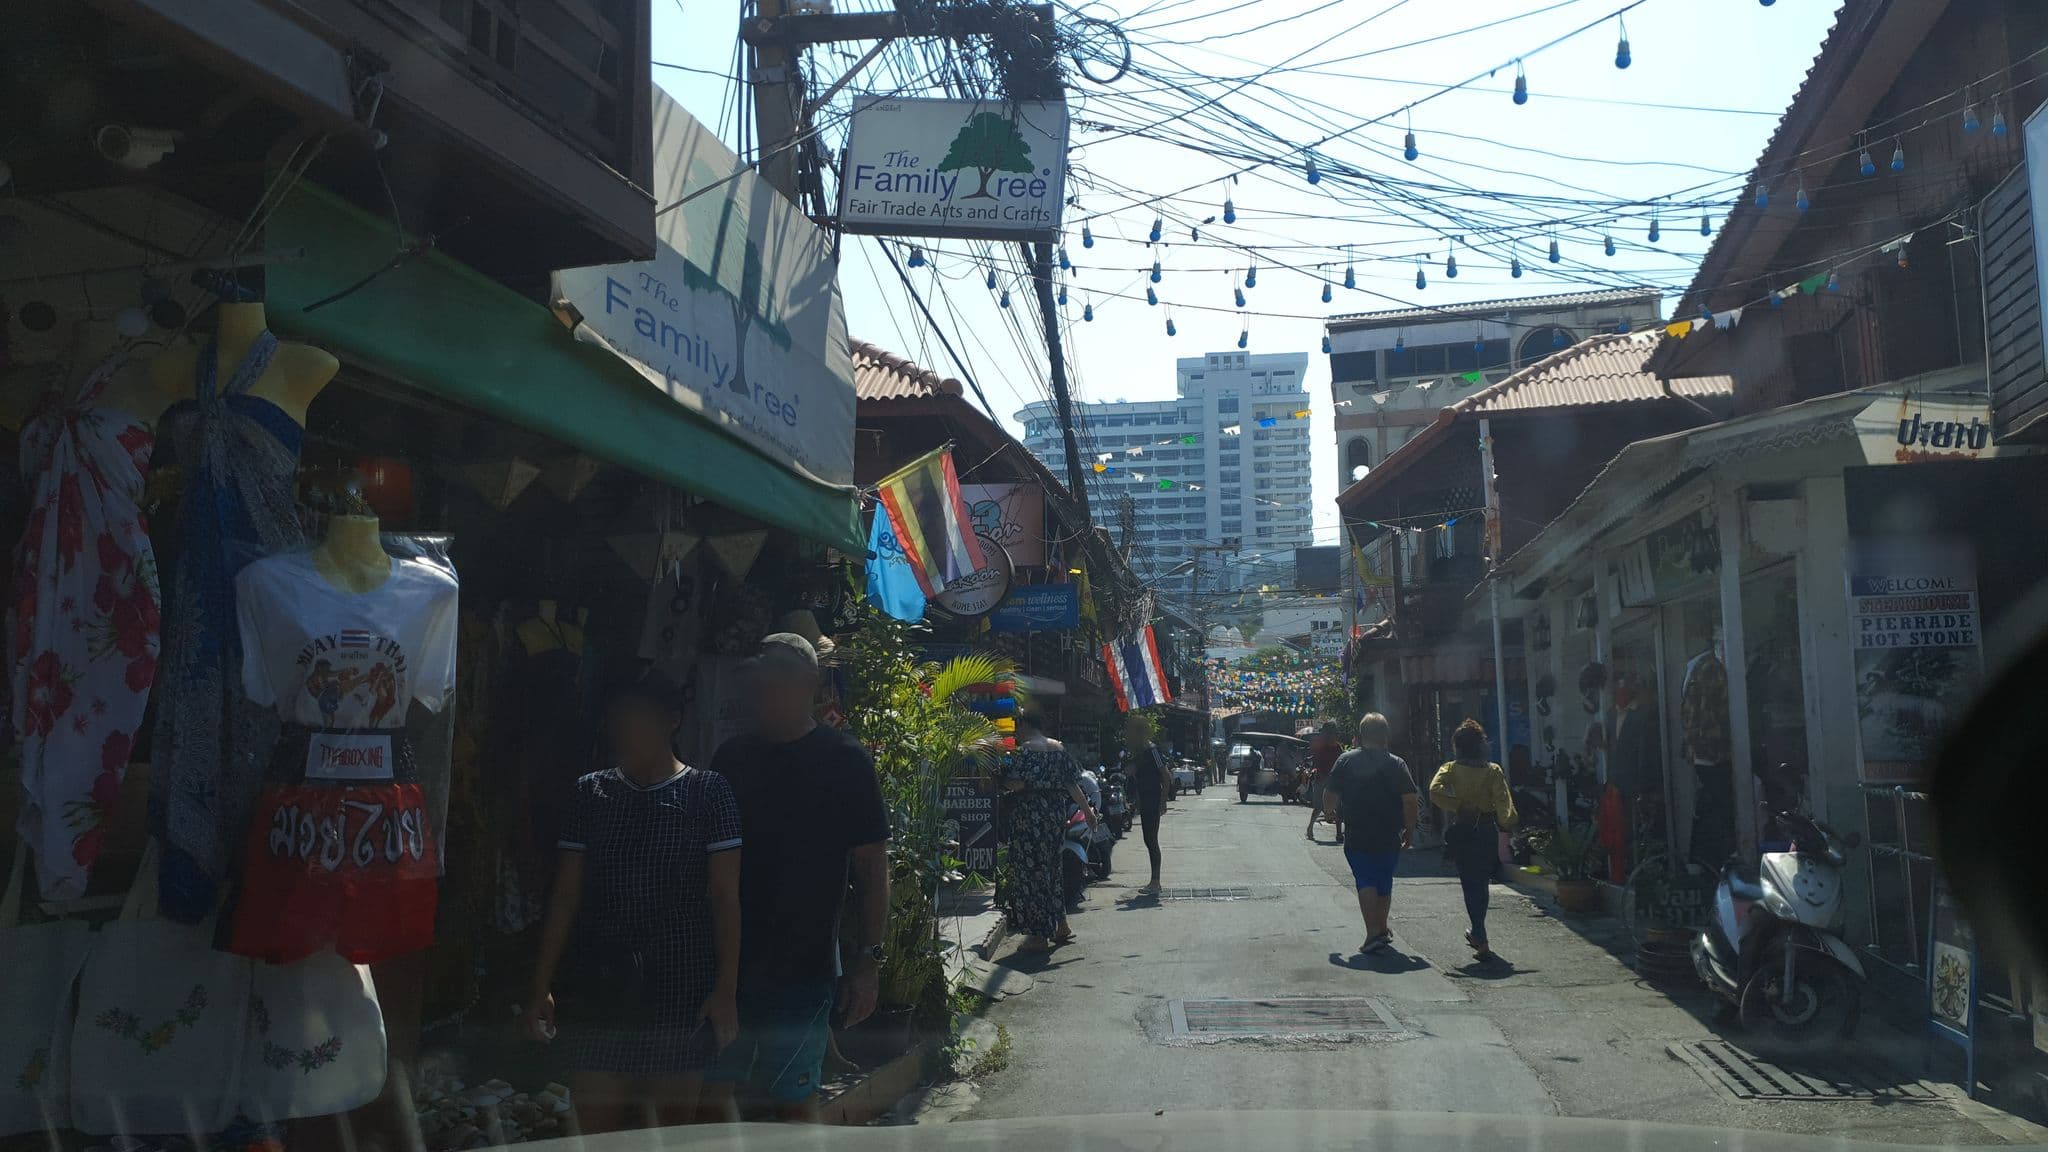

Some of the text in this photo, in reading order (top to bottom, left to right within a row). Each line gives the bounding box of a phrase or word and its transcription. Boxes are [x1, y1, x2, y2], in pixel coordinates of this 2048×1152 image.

[884, 149, 919, 168] The
[854, 165, 957, 201] Family
[849, 199, 1050, 221] Fair Trade Arts and Crafts
[639, 272, 680, 312] The
[606, 276, 730, 388] Family
[1868, 576, 1954, 592] WELCOME
[1861, 615, 1972, 631] PIERRADE
[1861, 630, 1974, 647] HOT STONE
[943, 798, 992, 809] BARBER
[960, 812, 991, 822] SHOP
[965, 847, 993, 870] OPEN
